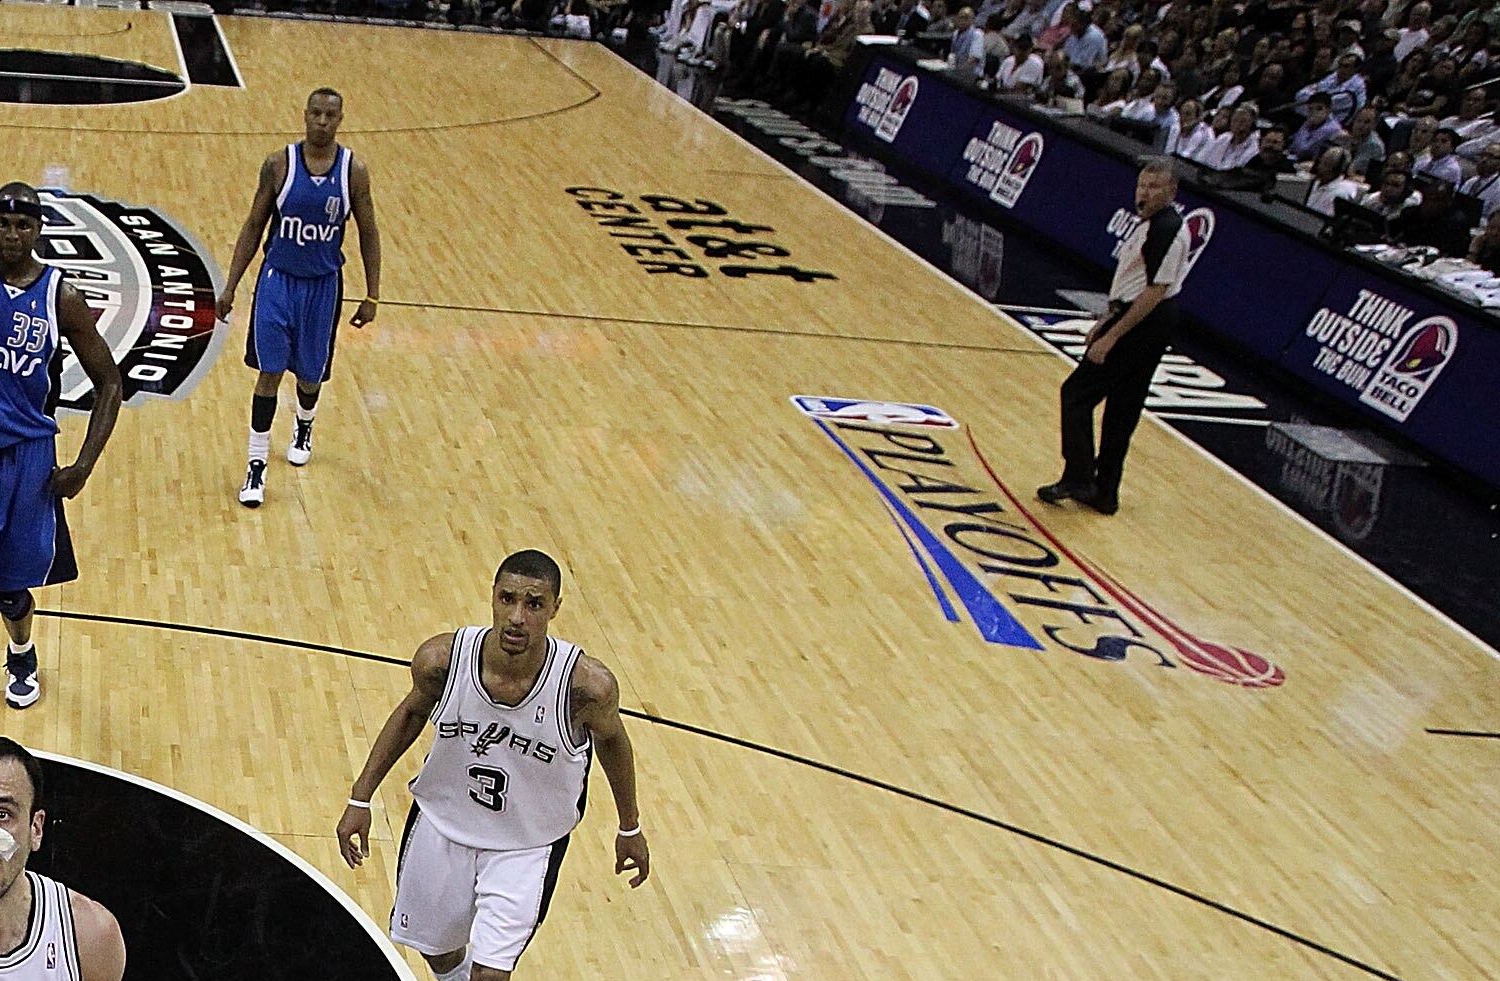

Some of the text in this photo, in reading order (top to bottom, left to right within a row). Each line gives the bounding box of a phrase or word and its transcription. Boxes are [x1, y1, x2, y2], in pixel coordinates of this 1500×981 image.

[325, 195, 341, 223] 4
[565, 186, 710, 278] CENTER
[119, 214, 196, 382] SAN ANTONIO
[1348, 288, 1416, 339] THINK
[7, 311, 50, 354] 33
[1306, 307, 1393, 369] OUTSIDE
[1312, 345, 1344, 376] THE
[1370, 385, 1410, 413] BELL
[1379, 371, 1420, 399] TACO
[831, 421, 1178, 669] PLAYOFFS
[438, 720, 558, 766] SPURS
[466, 762, 510, 815] 3
